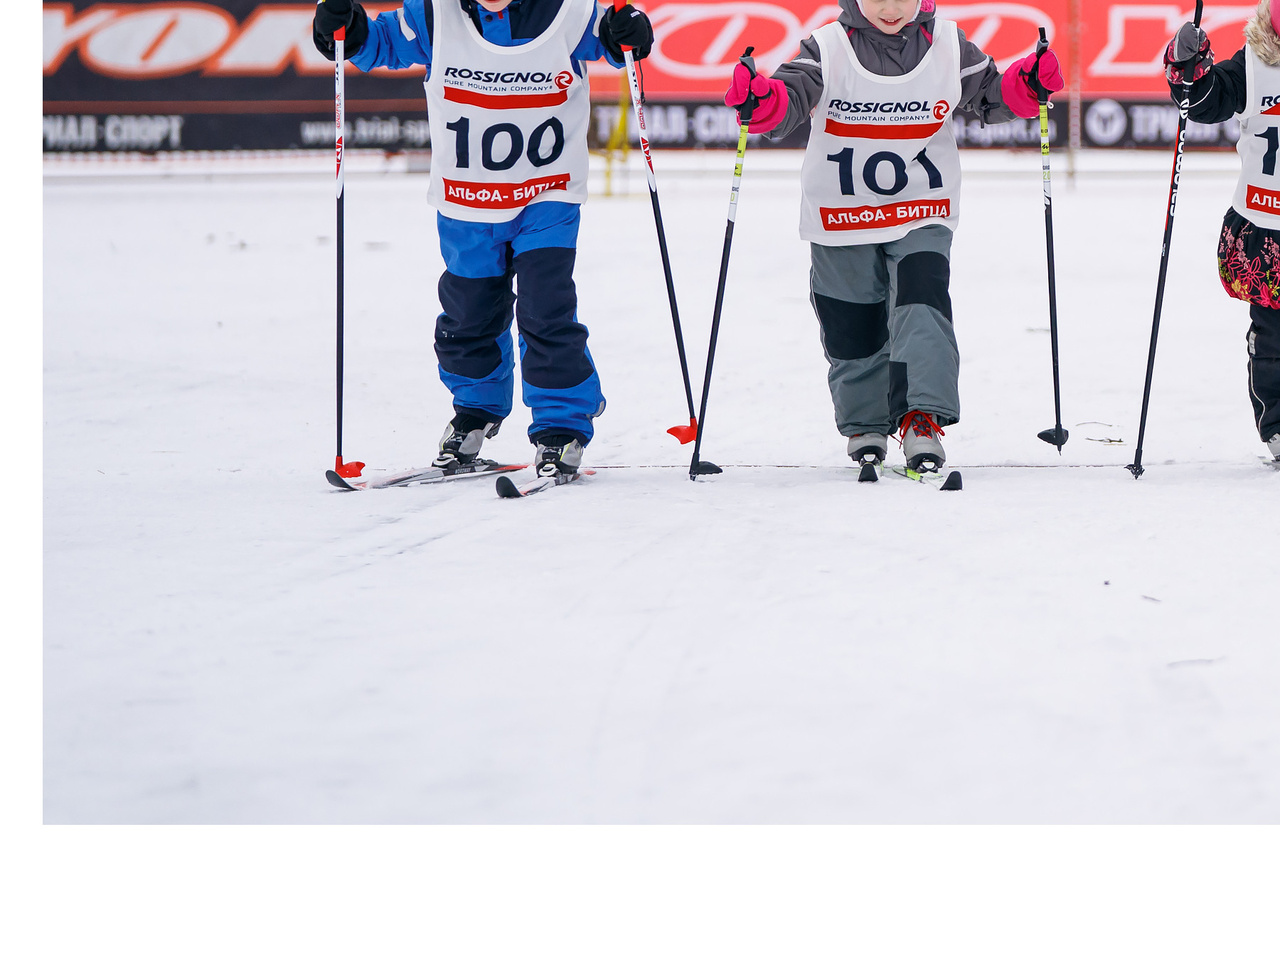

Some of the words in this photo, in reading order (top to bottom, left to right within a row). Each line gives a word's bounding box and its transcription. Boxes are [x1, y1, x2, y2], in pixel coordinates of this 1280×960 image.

[444, 67, 553, 84] ROSSIGNOL
[444, 78, 464, 87] PURE
[467, 82, 507, 92] MOUNTAIN
[828, 99, 931, 113] ROSSIGNOL
[446, 116, 565, 171] 100
[826, 147, 943, 196] 101
[513, 179, 565, 200] БИТ
[896, 205, 948, 218] БИТЦА
